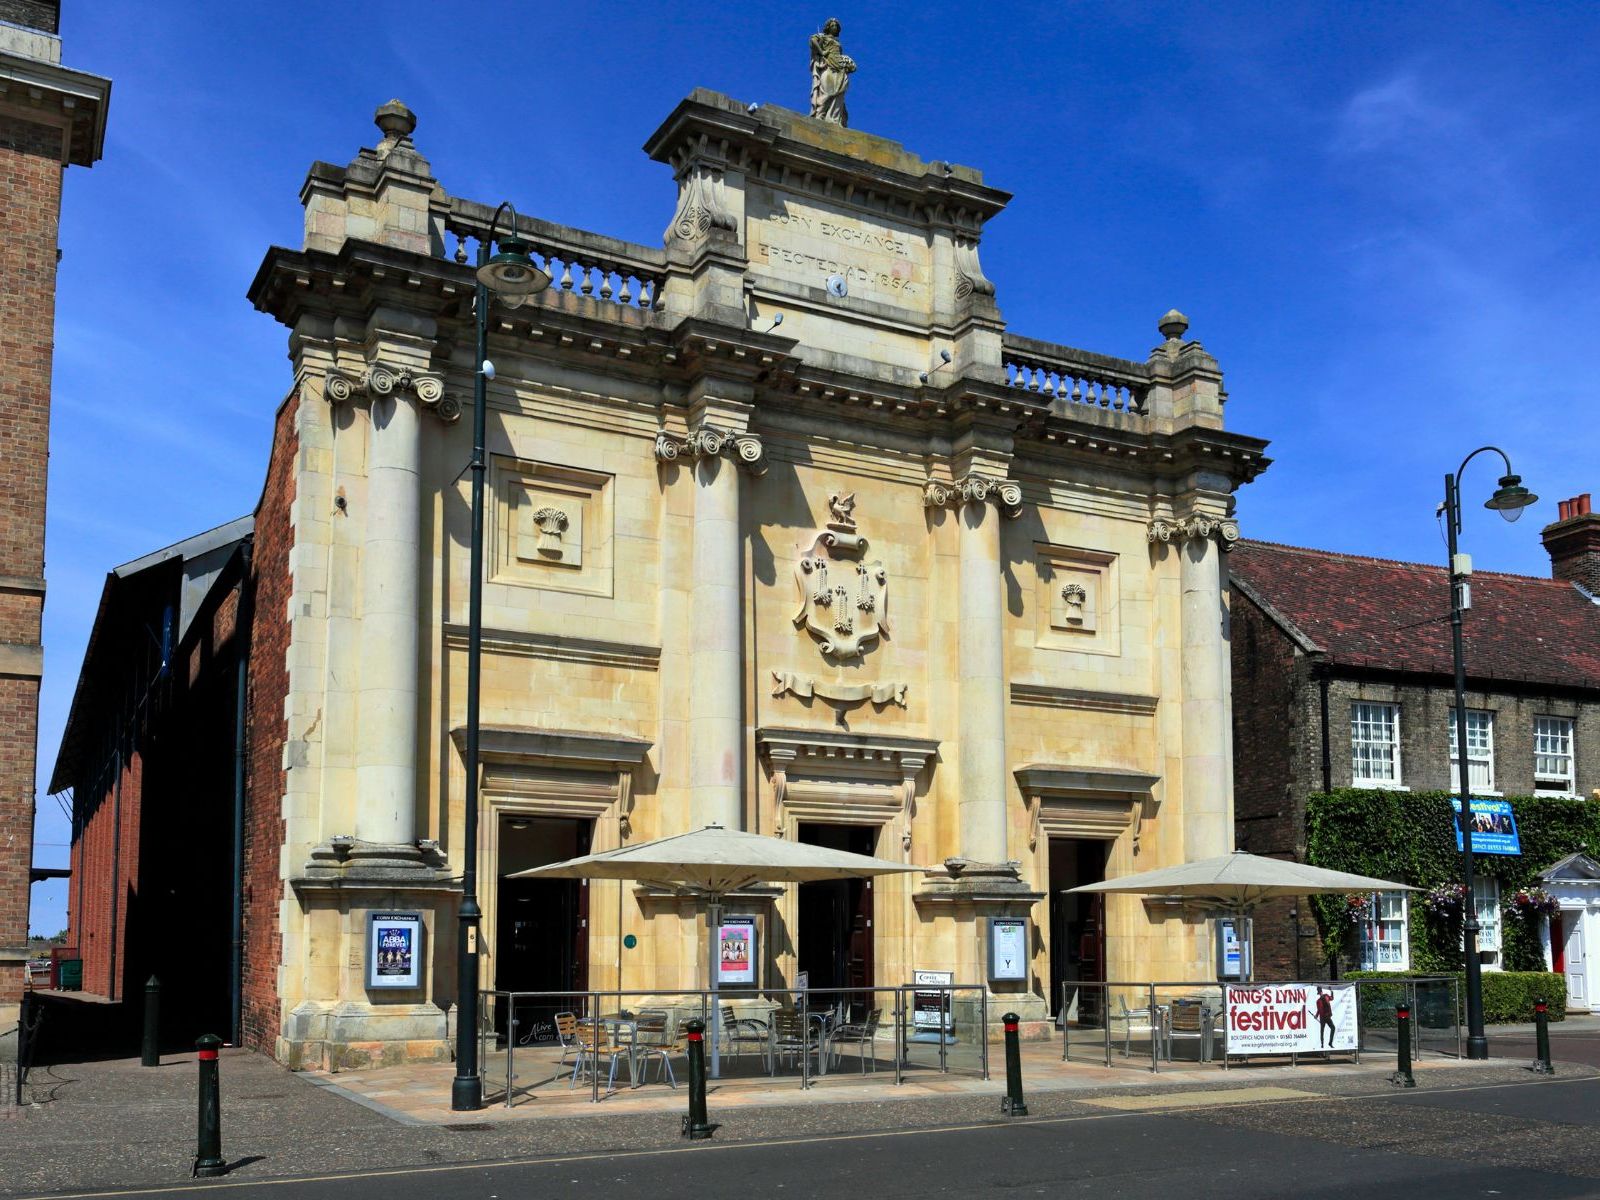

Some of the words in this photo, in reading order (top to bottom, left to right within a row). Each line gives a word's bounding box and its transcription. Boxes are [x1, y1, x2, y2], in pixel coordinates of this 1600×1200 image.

[383, 935, 406, 943] ABBA
[1229, 988, 1272, 1004] KING'S
[1275, 988, 1307, 1004] LYNN
[1229, 1005, 1307, 1031] festival
